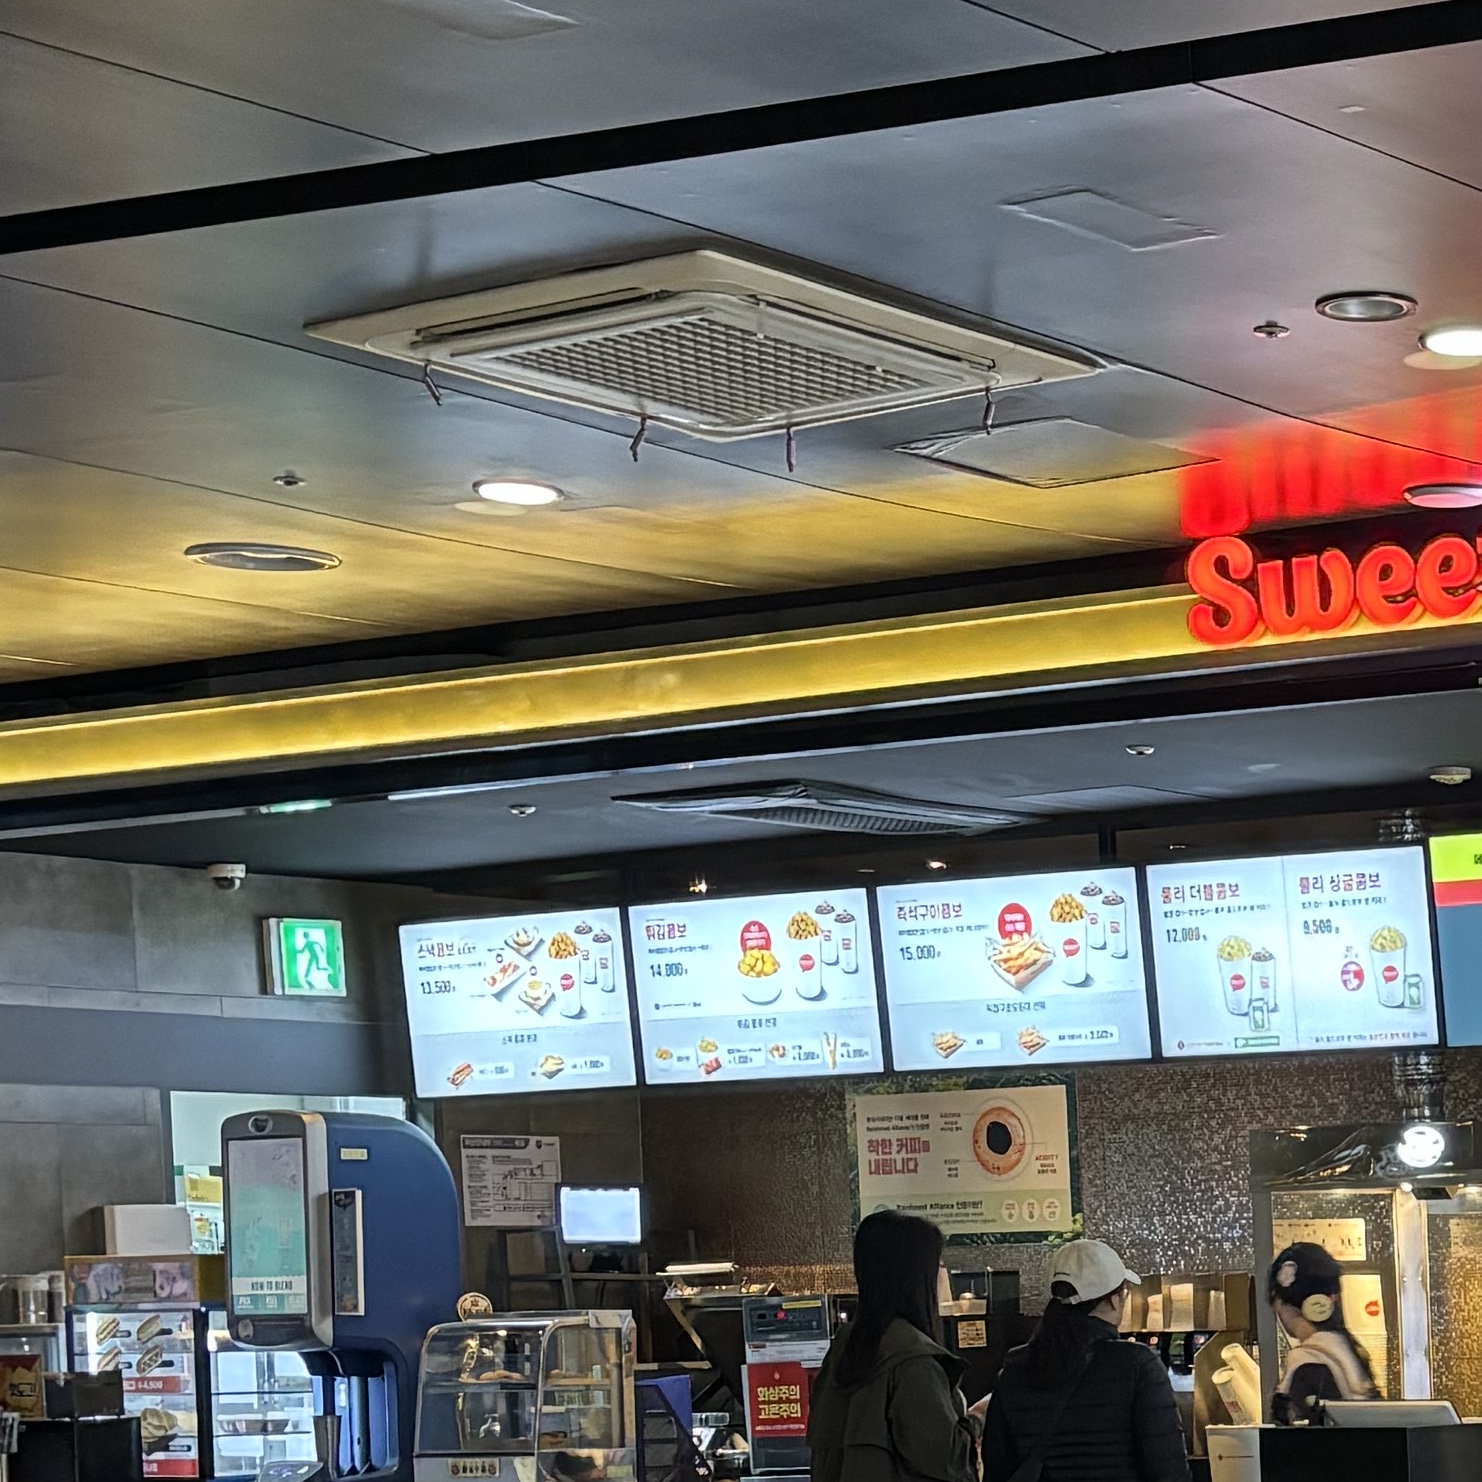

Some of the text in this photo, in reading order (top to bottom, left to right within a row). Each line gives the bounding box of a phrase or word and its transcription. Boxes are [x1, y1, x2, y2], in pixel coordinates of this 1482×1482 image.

[867, 1138, 893, 1156] 착한
[868, 1157, 919, 1175] 내립니다
[757, 1385, 800, 1402] 화상주의
